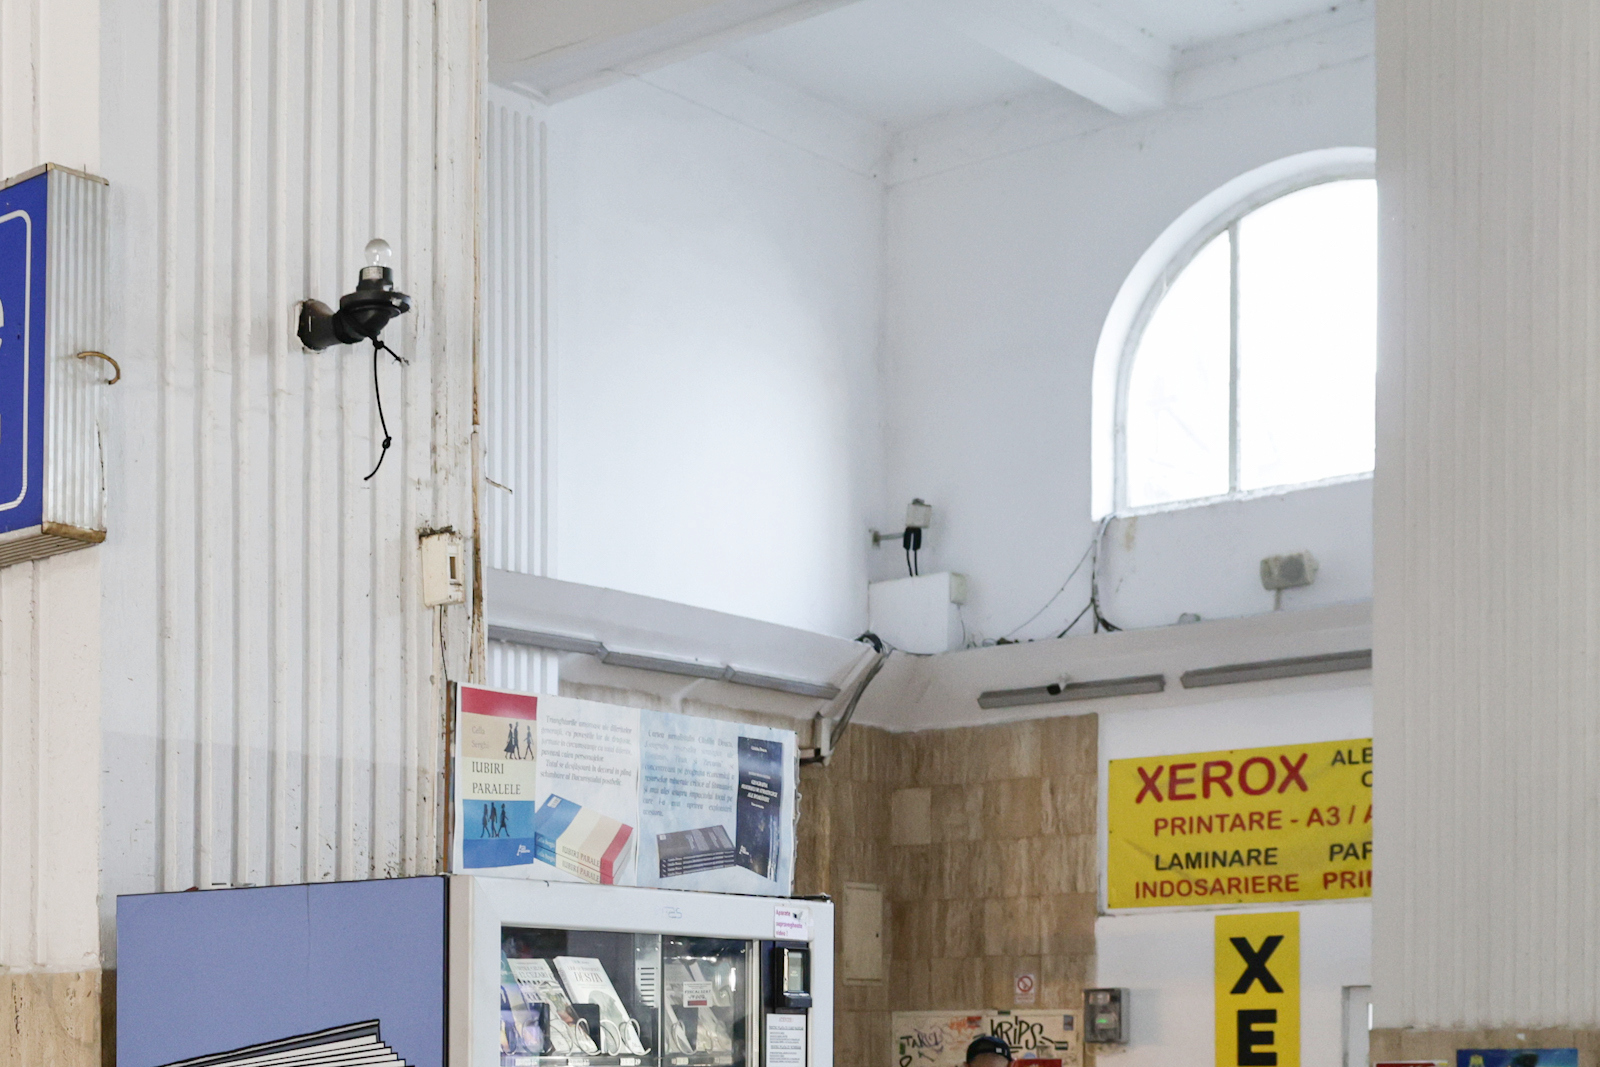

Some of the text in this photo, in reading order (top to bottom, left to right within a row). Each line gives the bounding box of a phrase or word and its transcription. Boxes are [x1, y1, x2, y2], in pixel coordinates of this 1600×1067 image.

[472, 761, 504, 774] IUBIRI
[1136, 753, 1308, 804] XEROX
[473, 783, 521, 794] PARALELE
[1155, 810, 1282, 836] PRINTARE
[1307, 807, 1340, 827] A3
[1155, 848, 1278, 870] LAMINARE
[1136, 874, 1299, 899] INDOSARIERE
